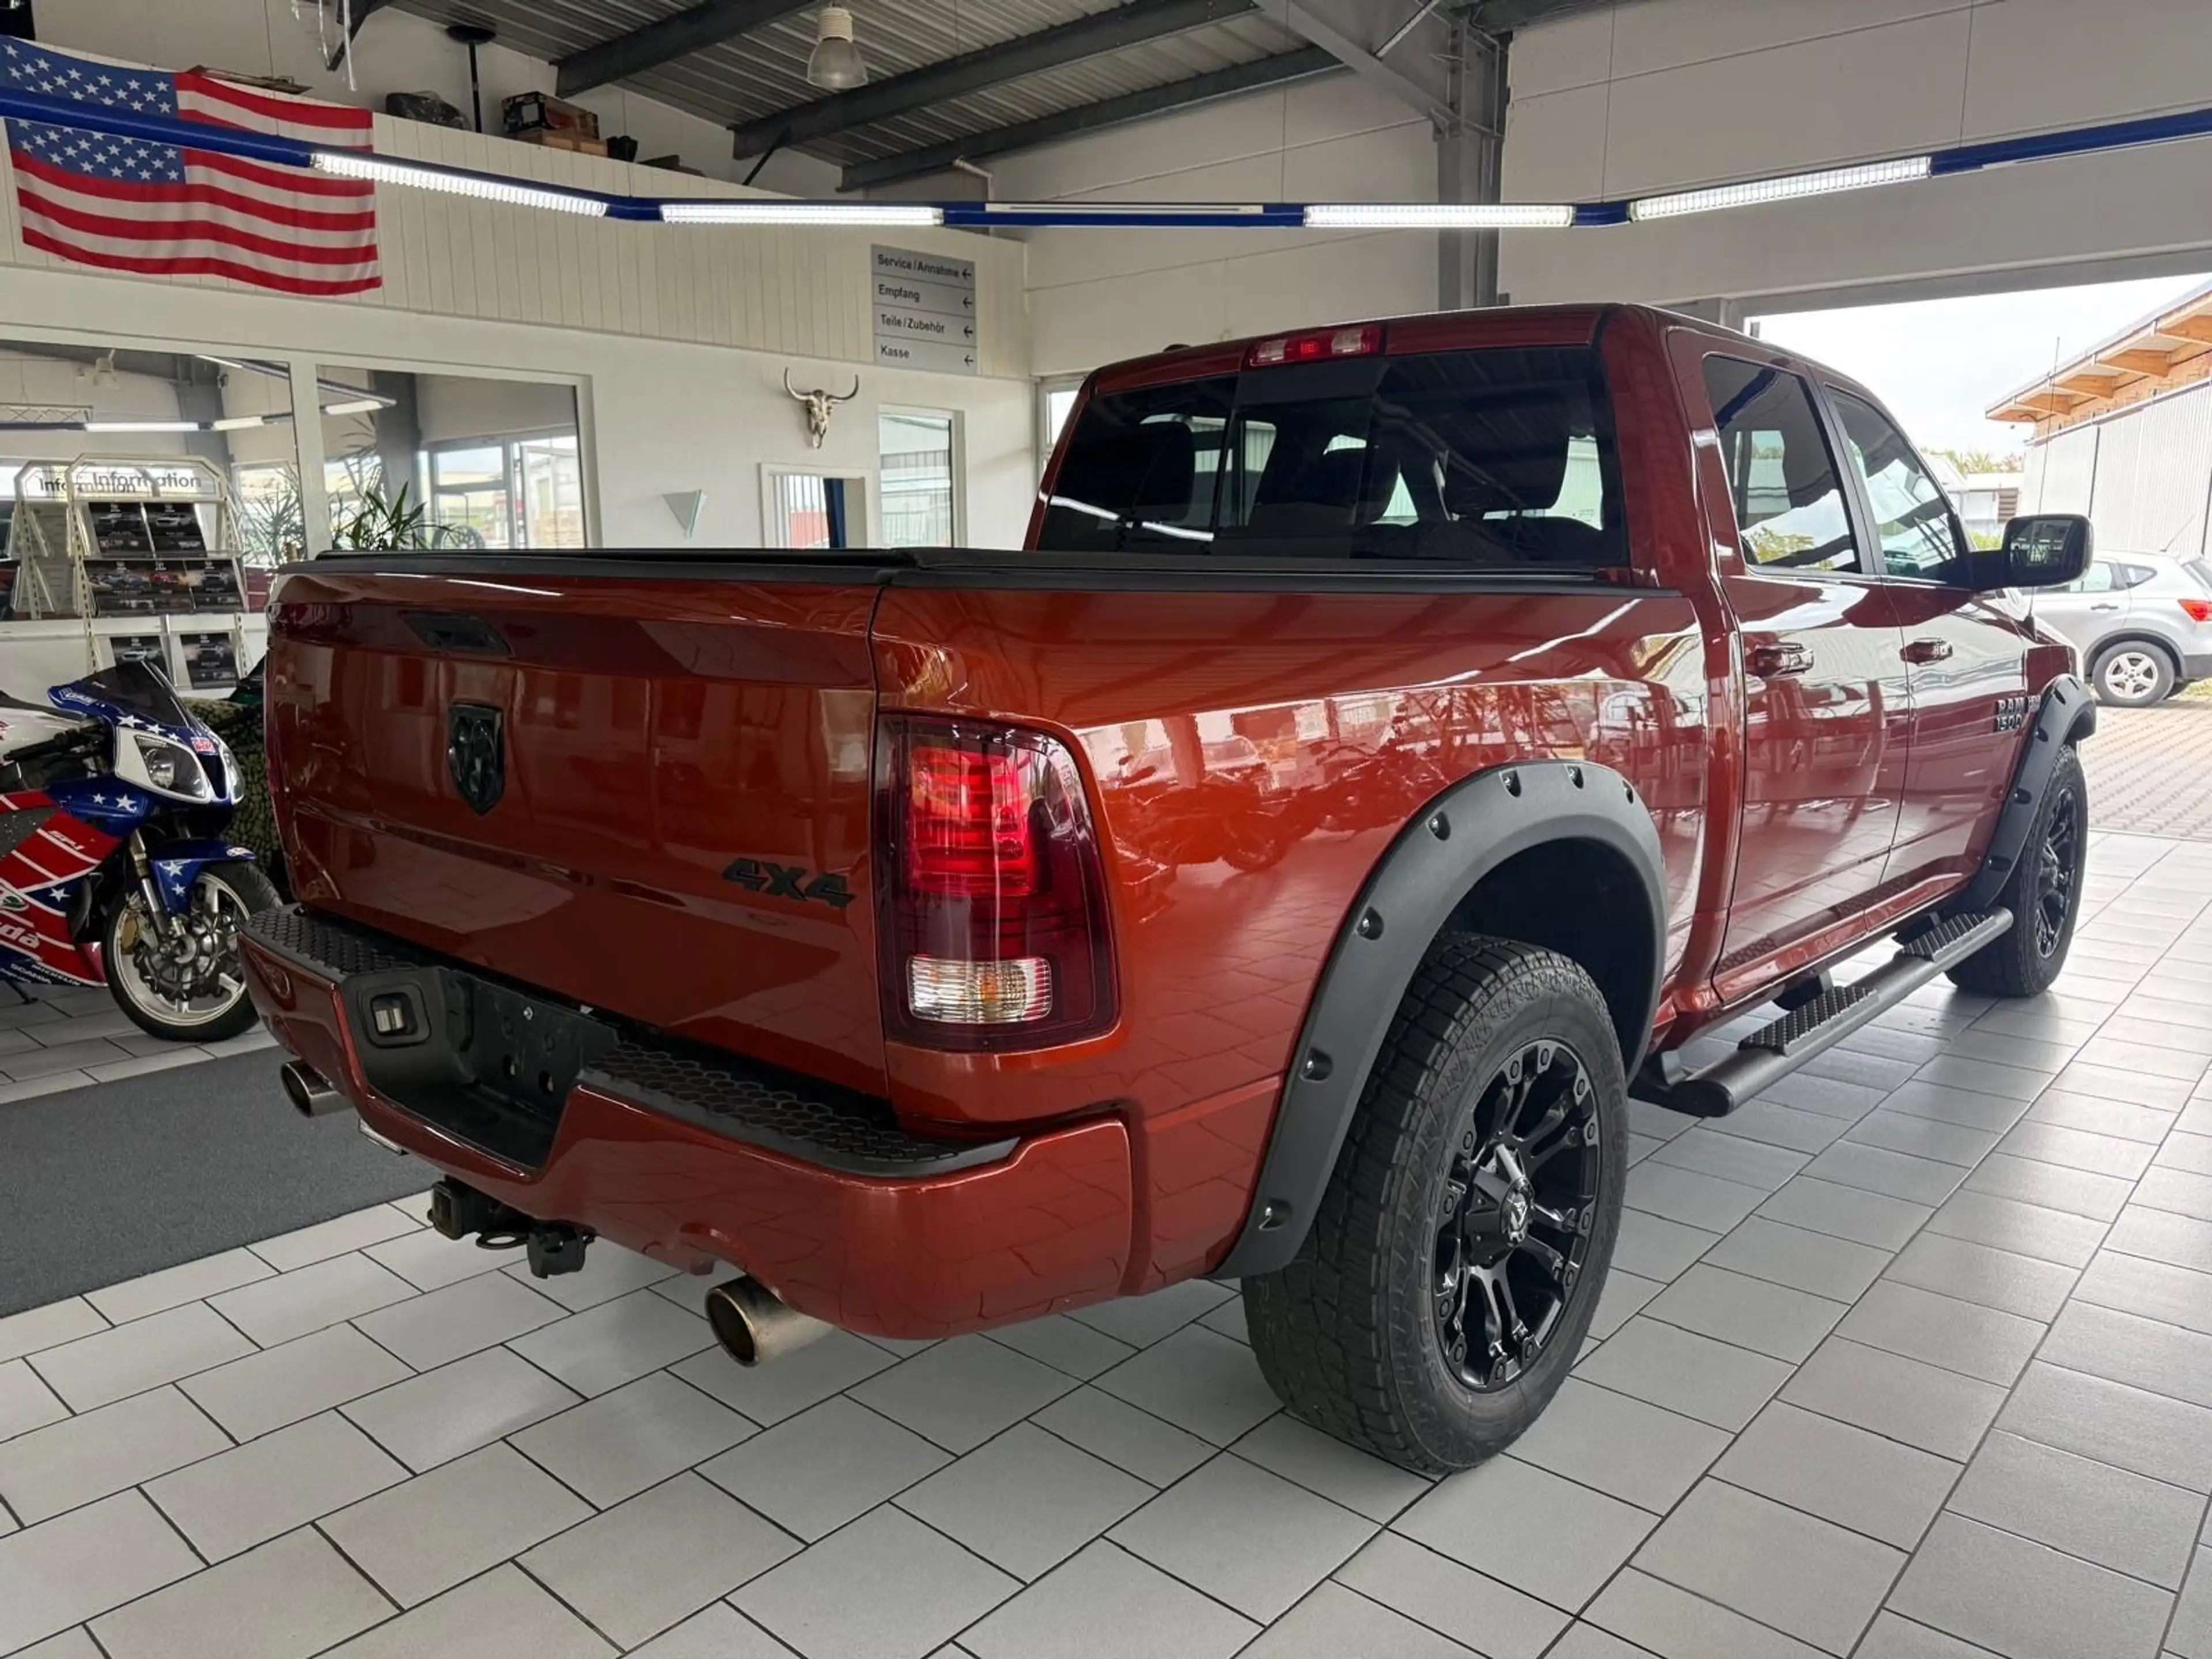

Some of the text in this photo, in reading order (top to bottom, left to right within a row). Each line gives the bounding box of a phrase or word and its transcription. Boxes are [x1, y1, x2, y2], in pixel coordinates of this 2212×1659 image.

[878, 284, 920, 302] Empfang
[880, 345, 910, 358] Kasse
[39, 478, 136, 493] Infomation
[93, 471, 201, 488] Information
[1997, 696, 2025, 715] RAM
[1997, 714, 2022, 731] 1500
